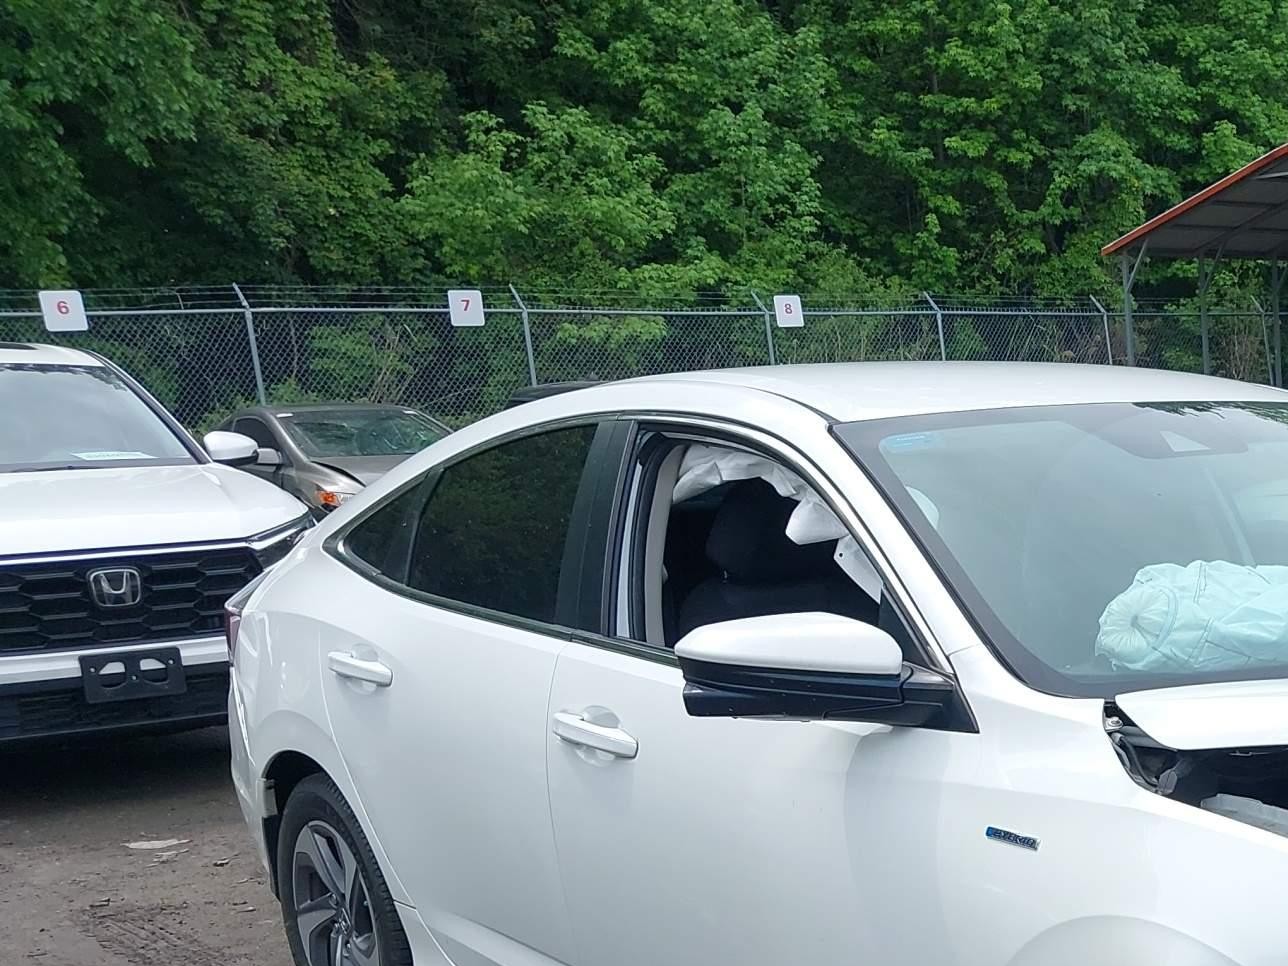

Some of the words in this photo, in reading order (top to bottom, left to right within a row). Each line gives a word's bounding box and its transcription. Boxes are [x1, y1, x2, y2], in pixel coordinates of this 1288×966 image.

[57, 300, 70, 315] 6
[460, 299, 471, 312] 7
[784, 303, 793, 315] 8
